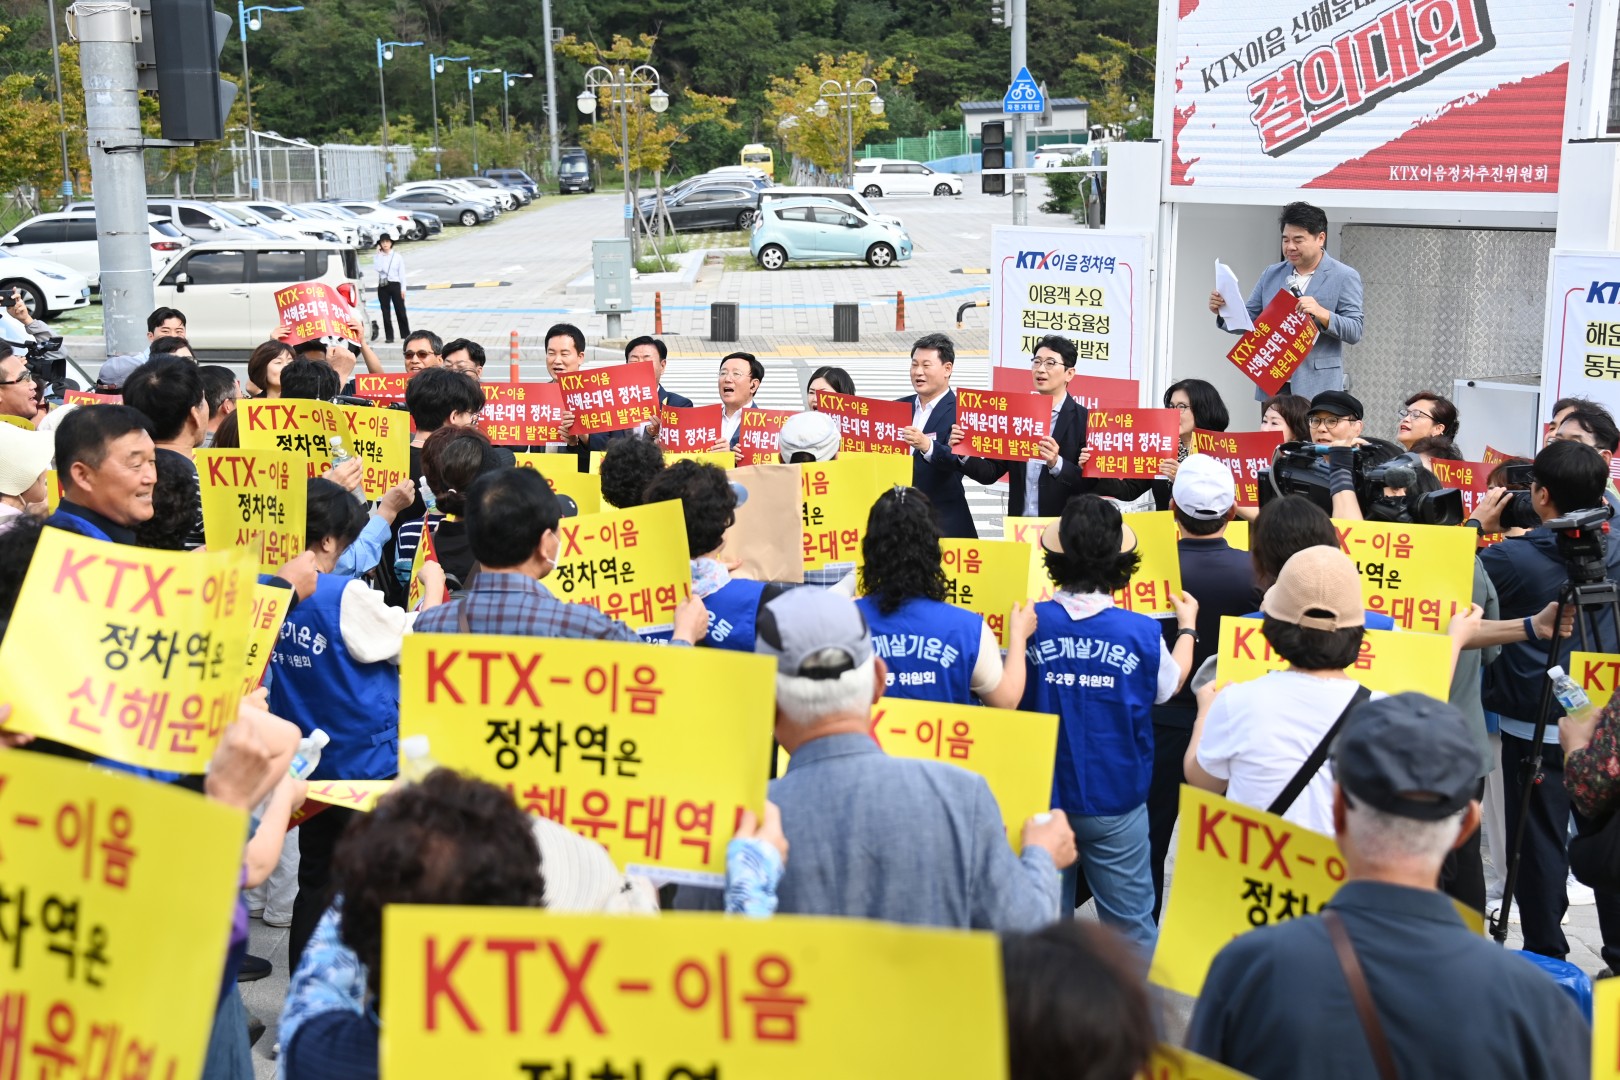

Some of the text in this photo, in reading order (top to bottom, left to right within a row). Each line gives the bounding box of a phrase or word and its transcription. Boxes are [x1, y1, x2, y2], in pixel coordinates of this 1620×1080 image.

[1029, 285, 1102, 307] 이용객 수요
[283, 300, 329, 326] 신해운대역
[296, 319, 327, 338] 해운대
[1246, 331, 1288, 377] 신해운대역
[1269, 349, 1298, 379] 해운대
[566, 385, 653, 412] 신해운대역 정차로
[530, 404, 562, 422] 정차로
[580, 410, 612, 429] 해운대
[487, 425, 520, 441] 해운대
[960, 411, 1044, 437] 신해운대역 정차로
[685, 427, 717, 446] 정차로
[971, 435, 1003, 454] 해운대
[1087, 432, 1172, 452] 신해운대역 정차로
[1096, 456, 1128, 473] 해운대
[238, 493, 285, 524] 정차역은
[556, 557, 635, 593] 정차역은
[100, 622, 224, 680] 정차역은
[899, 671, 936, 685] 위원회
[1045, 672, 1114, 688] 우2동 위원회
[485, 719, 643, 778] 정차역은
